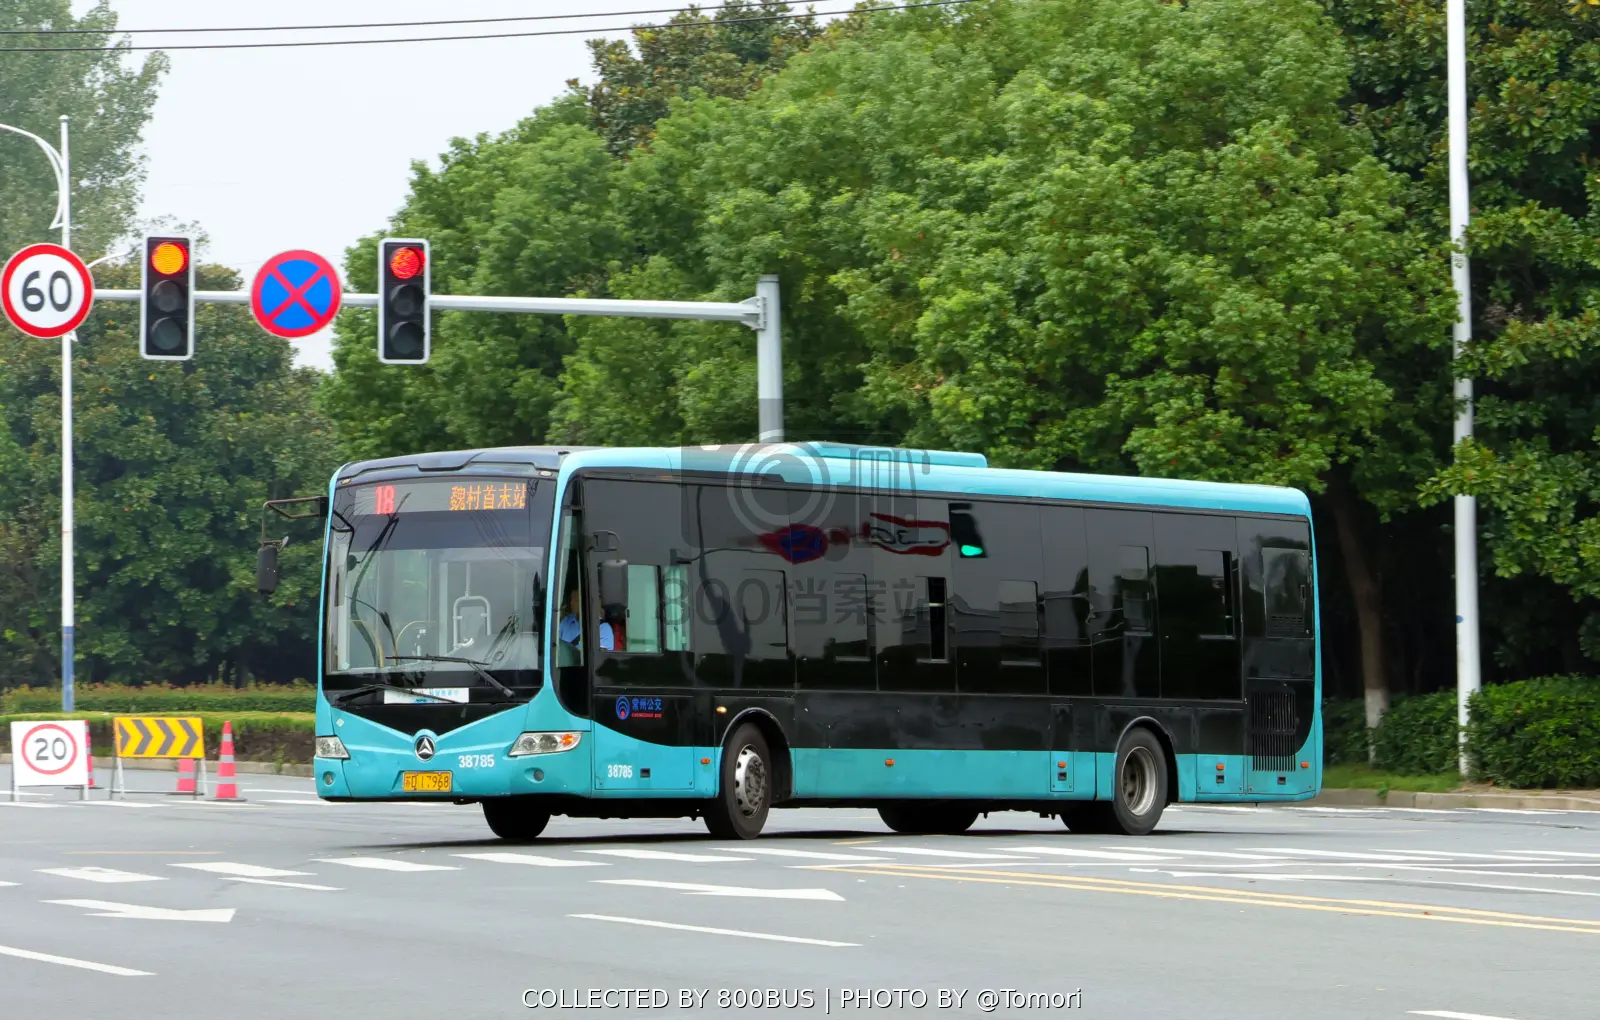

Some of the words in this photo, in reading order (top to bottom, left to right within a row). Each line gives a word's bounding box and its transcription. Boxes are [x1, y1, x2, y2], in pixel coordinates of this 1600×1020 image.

[22, 270, 72, 312] 60
[375, 485, 395, 515] 18
[450, 483, 527, 511] 魏村首末站
[631, 697, 662, 711] 常州公交
[35, 737, 67, 761] 20
[458, 754, 495, 768] 38785
[607, 764, 633, 778] 38785
